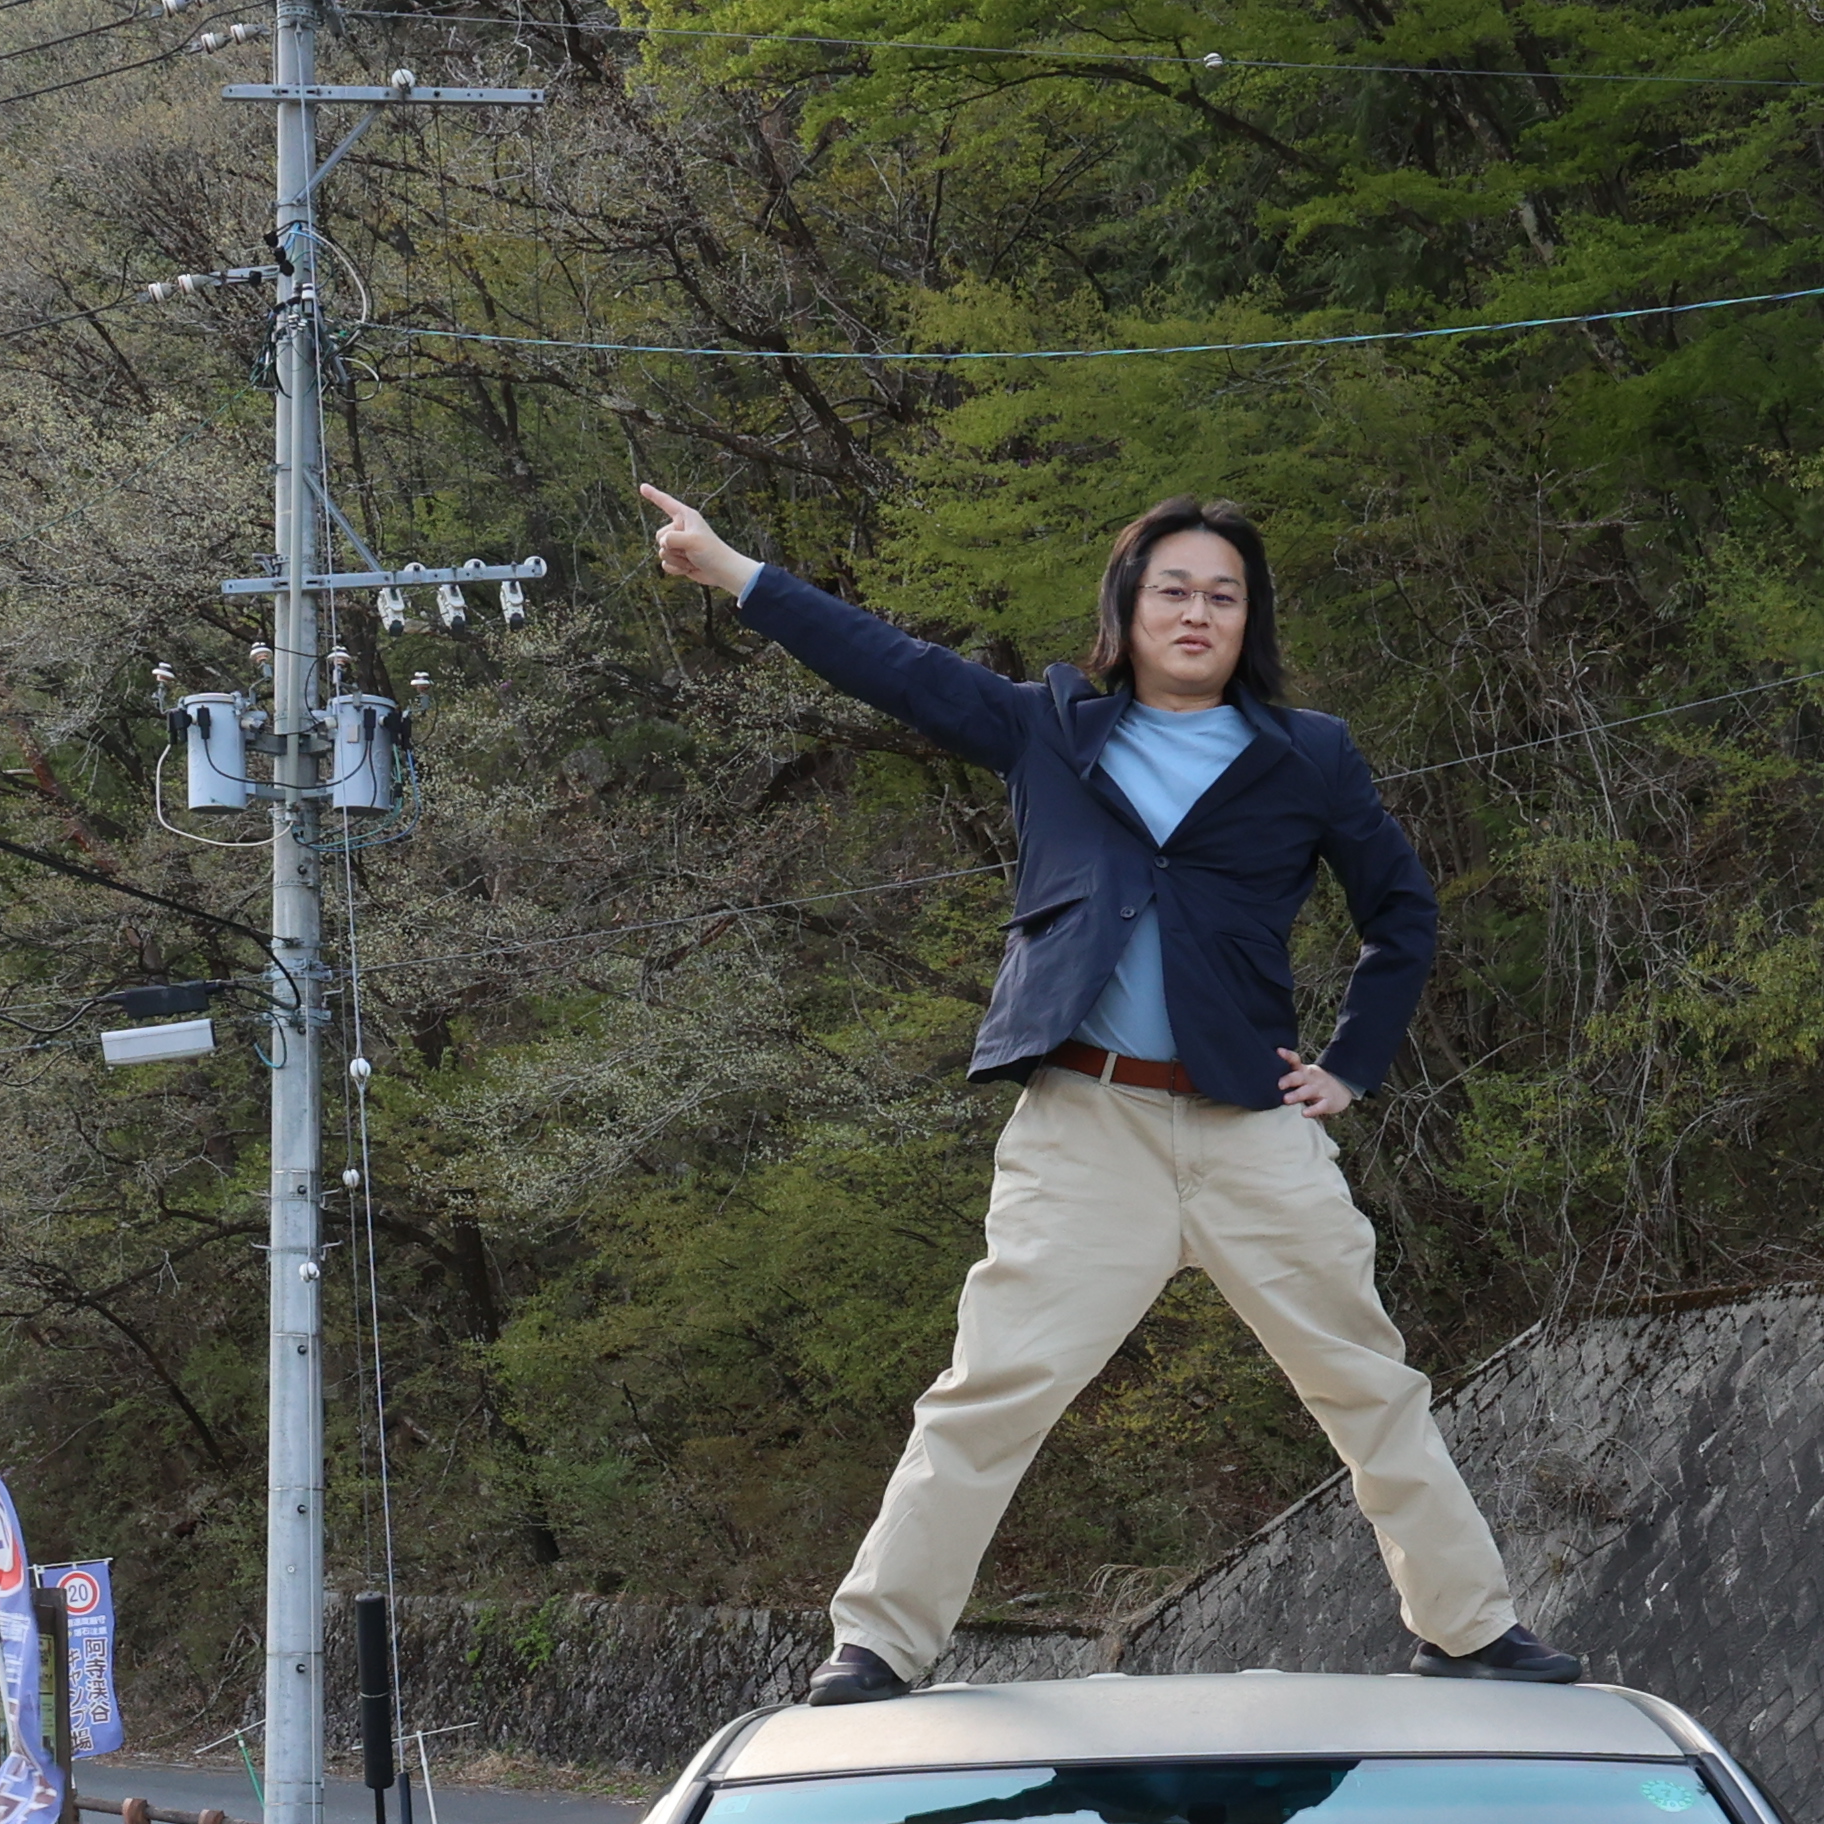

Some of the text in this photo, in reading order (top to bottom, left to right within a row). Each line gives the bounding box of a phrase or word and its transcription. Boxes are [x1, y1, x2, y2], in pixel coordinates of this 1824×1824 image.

[68, 1583, 88, 1602] 20
[84, 1637, 110, 1724] 阿寺渓谷
